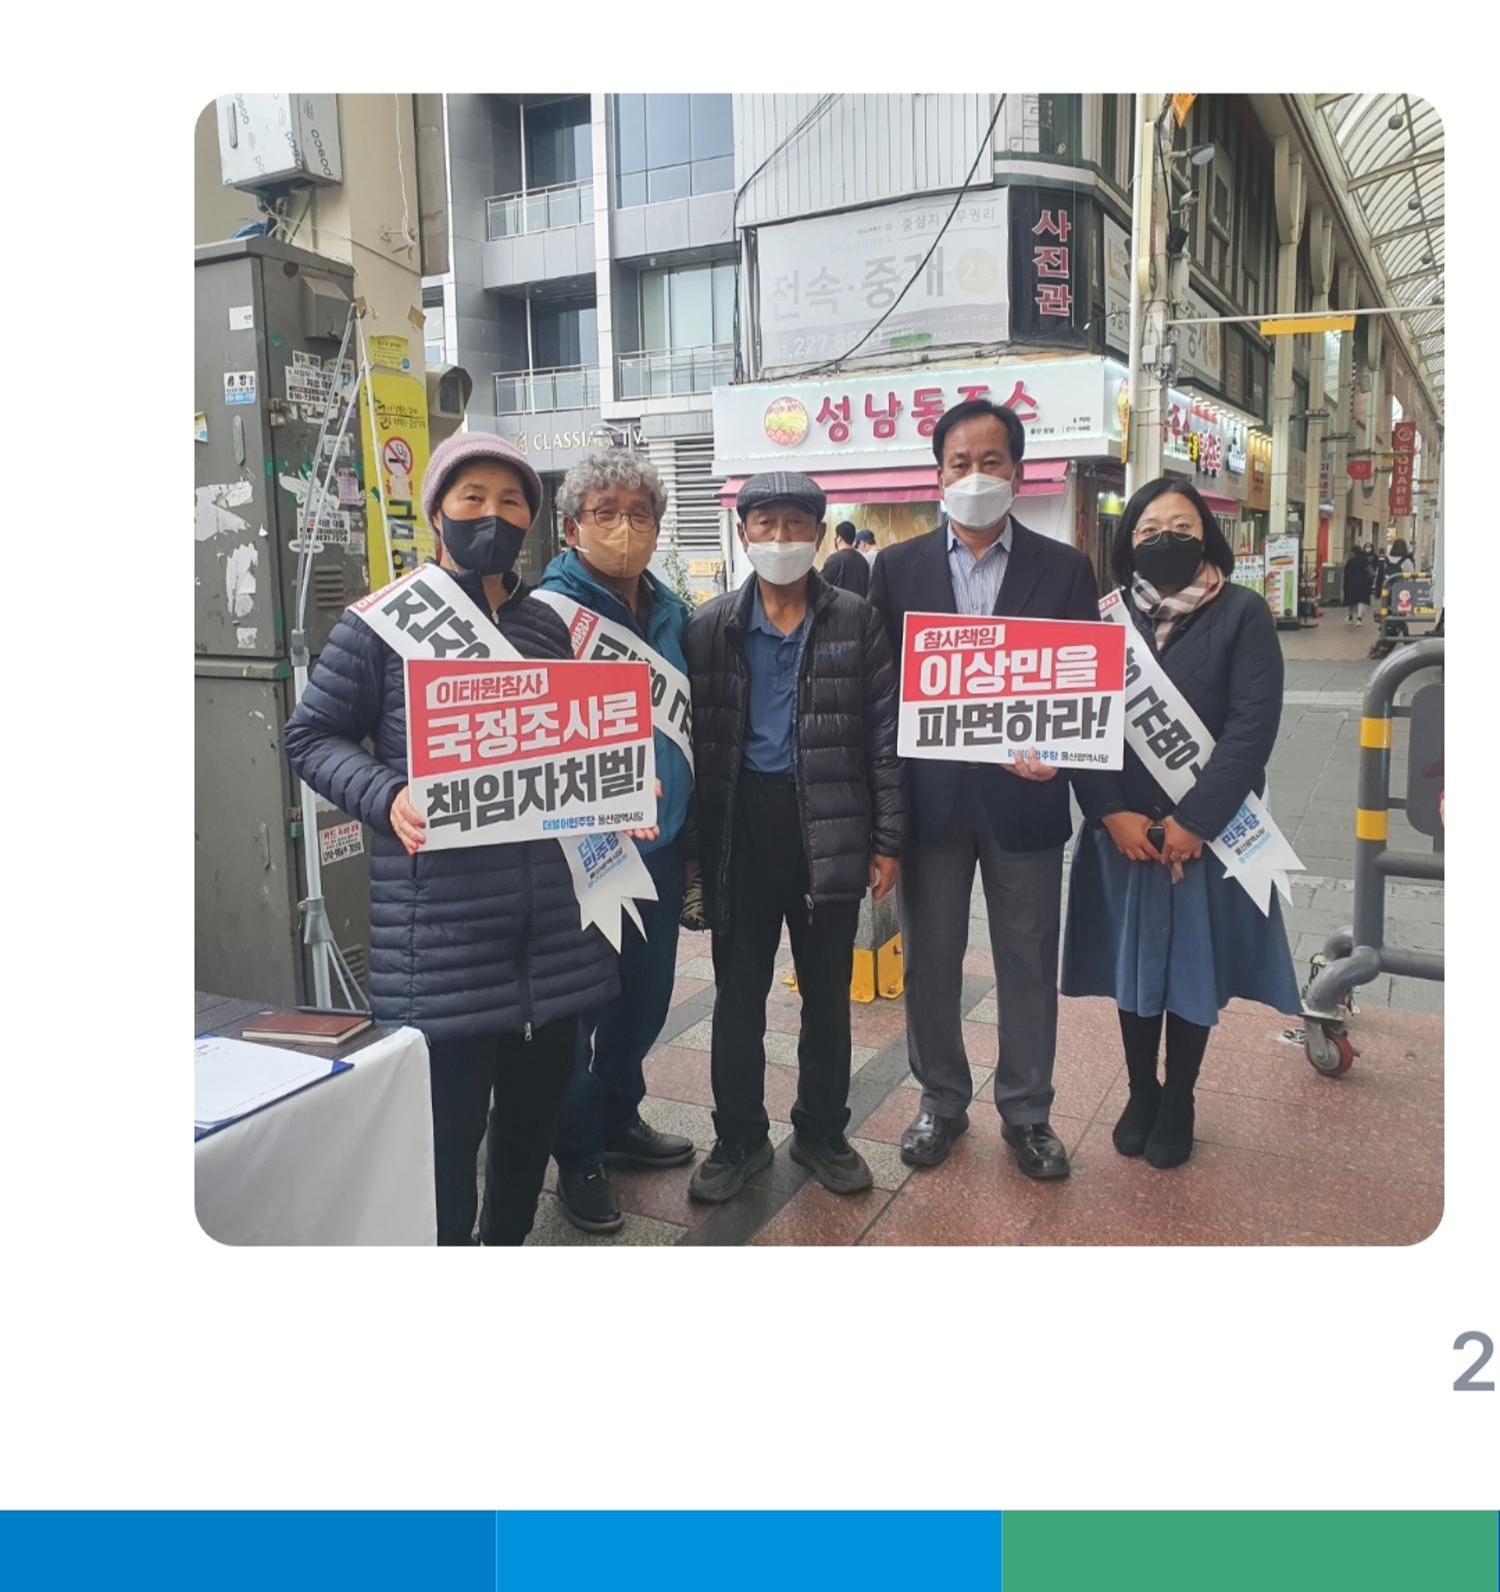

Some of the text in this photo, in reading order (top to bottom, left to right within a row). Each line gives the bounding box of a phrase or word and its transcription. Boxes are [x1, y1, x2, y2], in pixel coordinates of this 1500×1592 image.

[1031, 208, 1073, 317] 사진관
[922, 626, 998, 650] 참사책임
[435, 675, 543, 705] 이태원참사
[918, 643, 1100, 697] 이상민을
[426, 691, 640, 764] 국정조사로
[915, 694, 1113, 748] 파면하라!
[425, 743, 646, 833] 책임자처벌!
[542, 815, 596, 832] 더불어민주당
